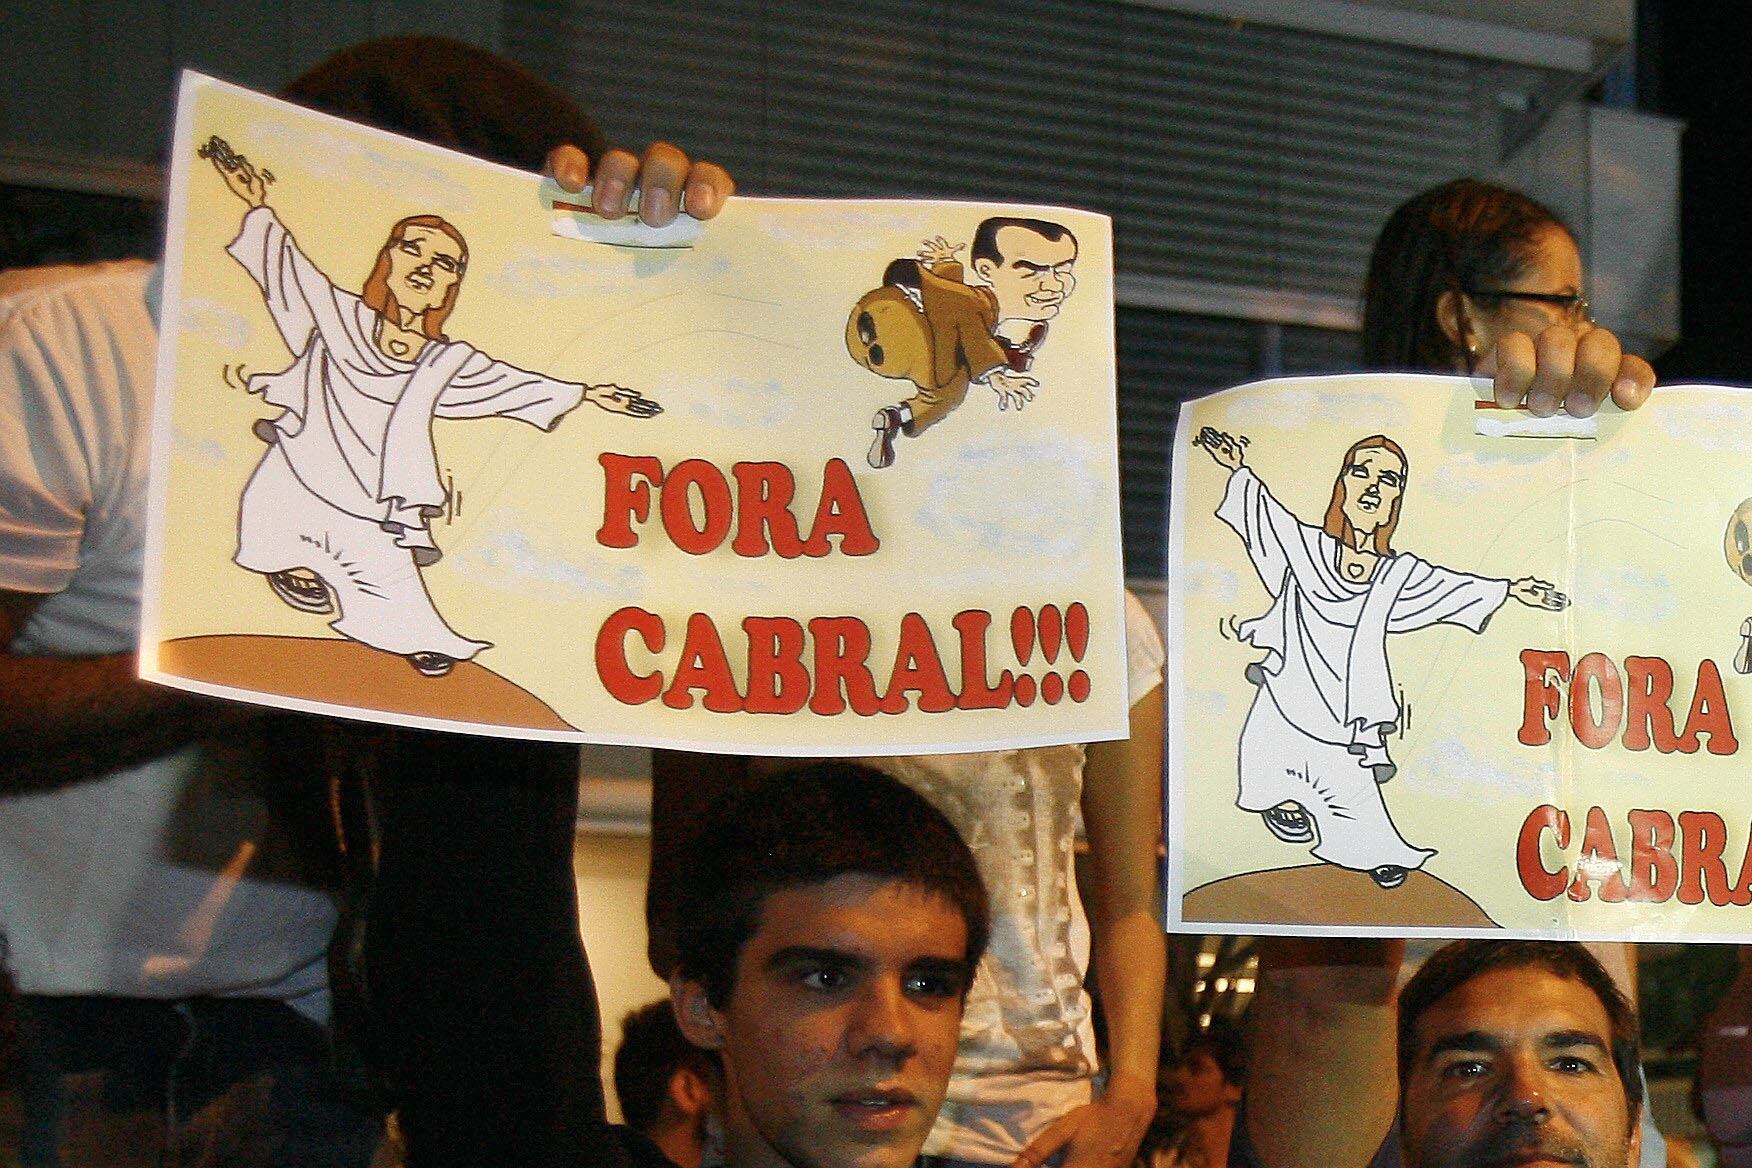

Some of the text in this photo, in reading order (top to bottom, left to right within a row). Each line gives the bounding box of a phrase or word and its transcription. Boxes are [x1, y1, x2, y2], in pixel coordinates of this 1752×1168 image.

[596, 451, 880, 559] FORA
[595, 600, 1092, 717] CABRAL!!!
[1516, 648, 1740, 756] FORA
